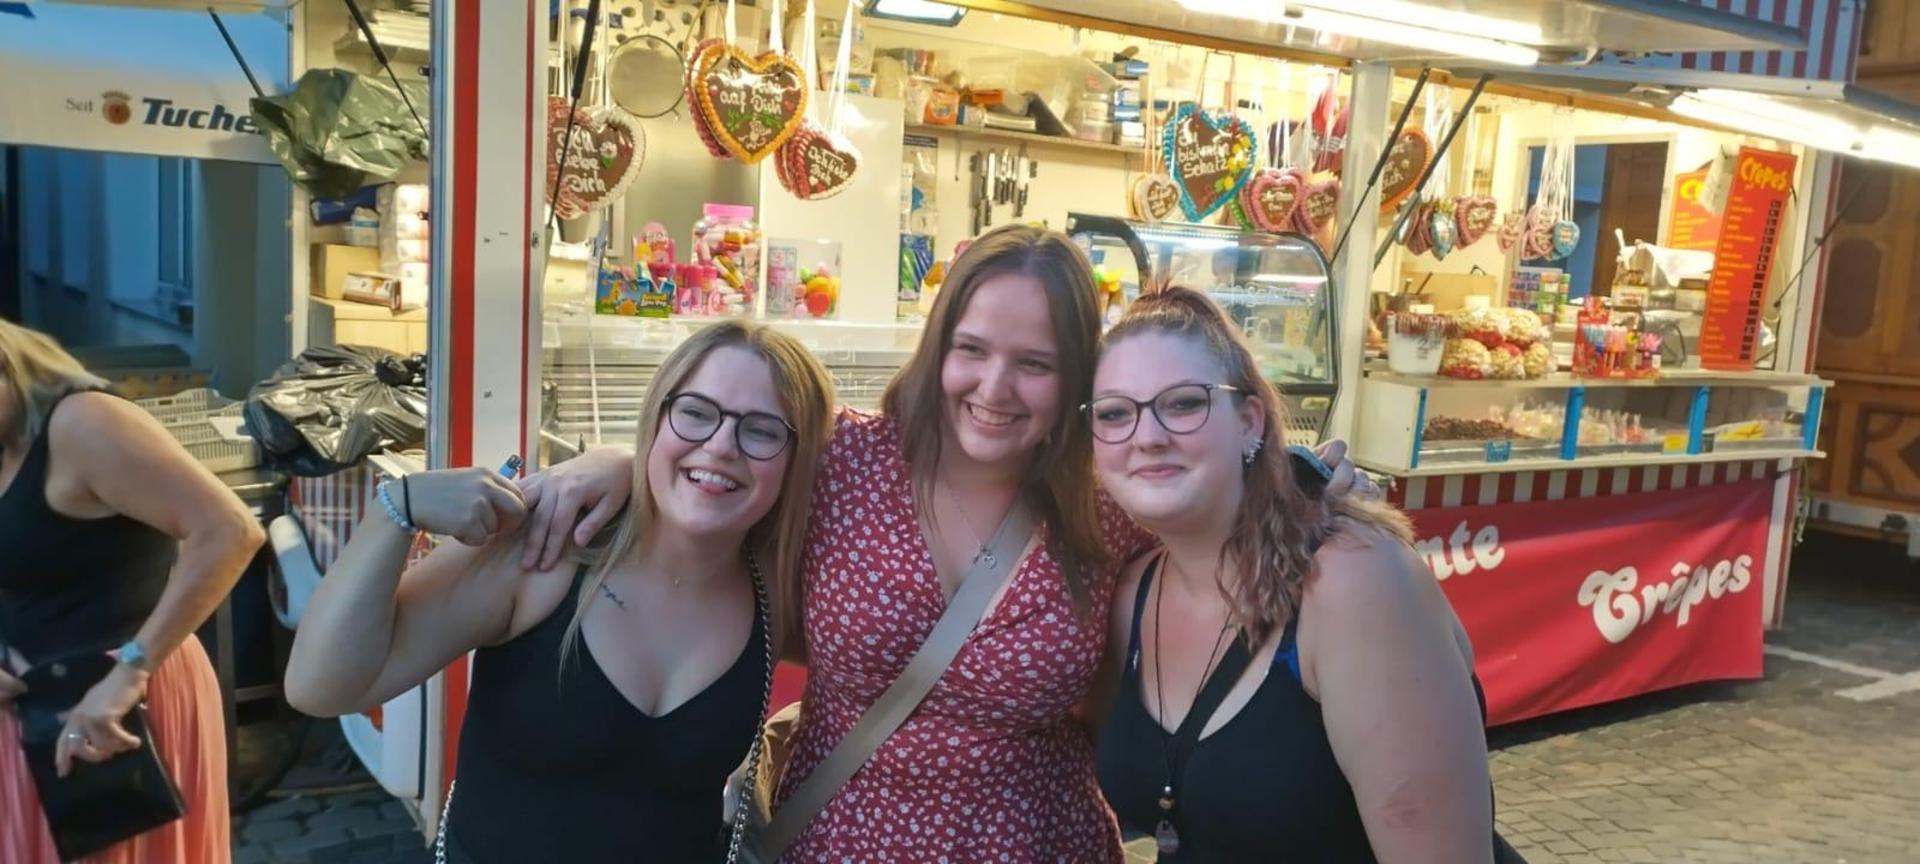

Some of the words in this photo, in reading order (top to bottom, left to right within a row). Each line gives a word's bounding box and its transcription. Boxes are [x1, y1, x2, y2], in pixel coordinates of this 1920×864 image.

[66, 98, 93, 112] Seit
[142, 97, 266, 134] Tuche
[719, 90, 747, 114] auf
[564, 169, 608, 193] Dich
[1183, 156, 1230, 179] Schatz
[1414, 519, 1506, 581] nte
[1577, 554, 1753, 644] Crêpes
